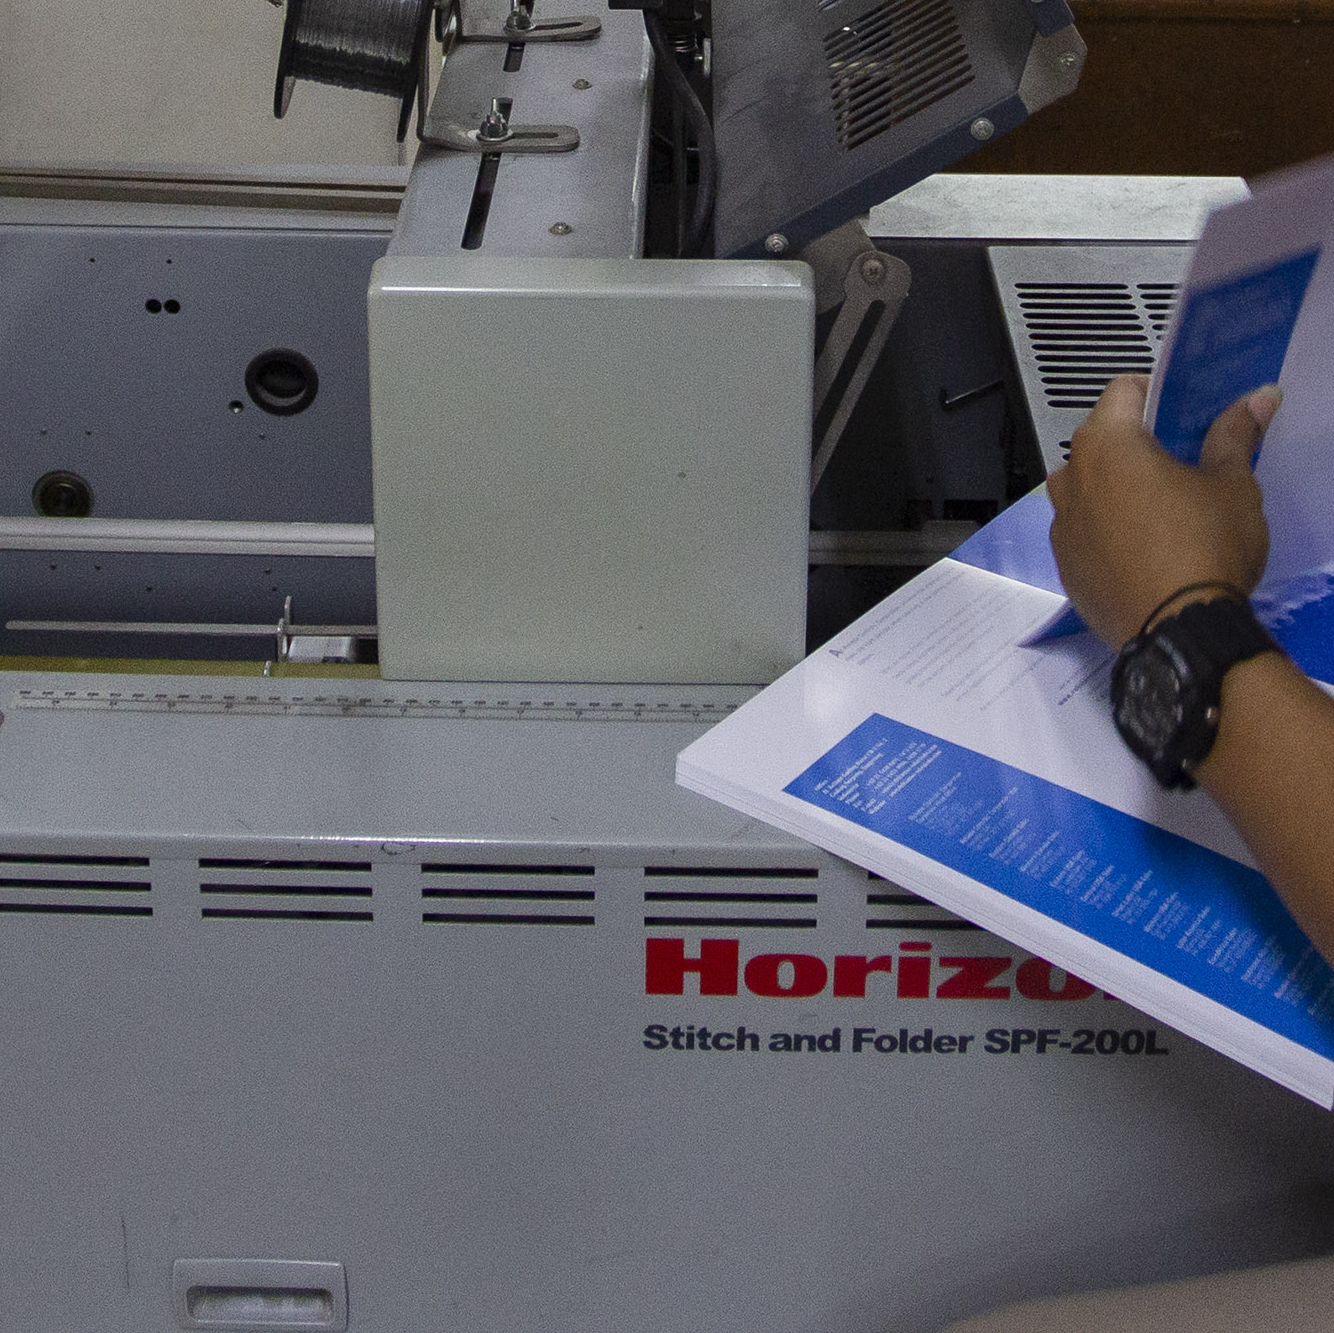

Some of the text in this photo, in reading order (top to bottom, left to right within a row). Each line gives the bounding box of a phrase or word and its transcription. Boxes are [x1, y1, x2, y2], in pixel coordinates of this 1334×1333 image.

[644, 937, 1129, 1001] Horizo
[642, 1023, 1169, 1057] Stitch and Folder SPF-200L
